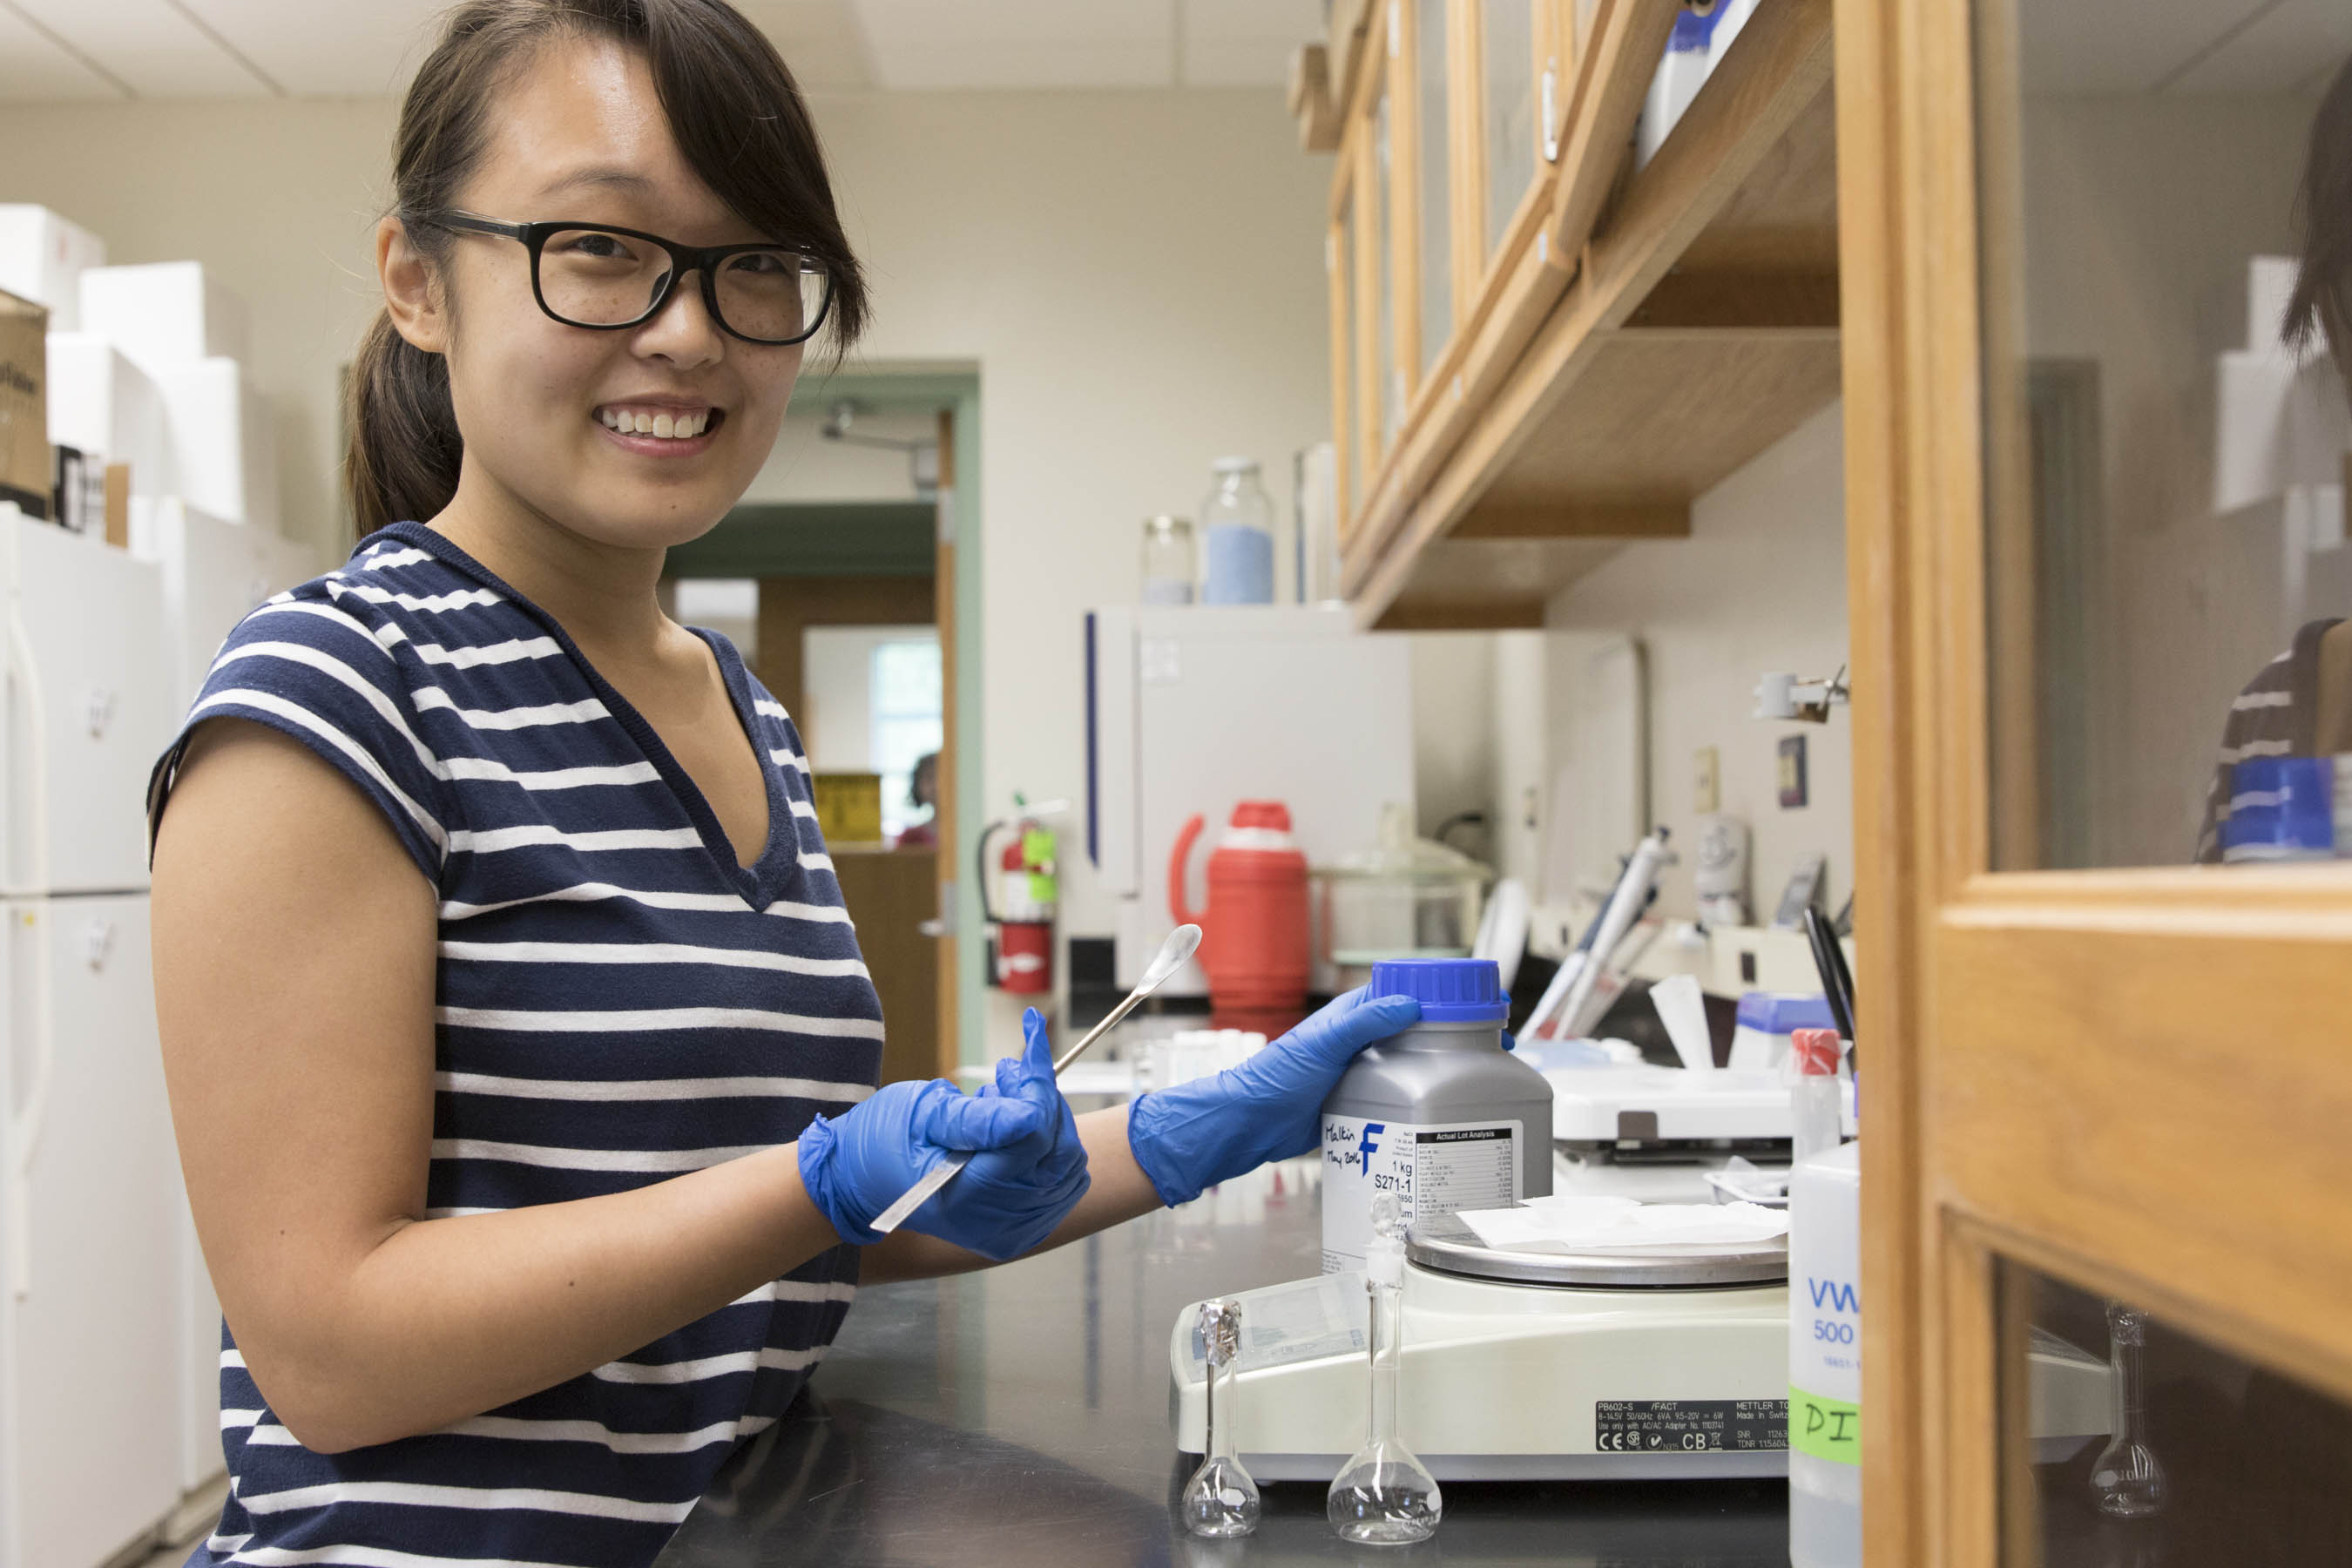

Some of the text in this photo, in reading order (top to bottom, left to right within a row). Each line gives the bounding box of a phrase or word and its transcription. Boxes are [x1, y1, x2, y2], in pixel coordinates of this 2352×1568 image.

[1469, 1131, 1495, 1139] Analysis
[1392, 1159, 1413, 1177] 1 kg
[1375, 1173, 1411, 1193] S271-1
[1814, 1319, 1854, 1345] 500
[1598, 1402, 1678, 1411] PB602-S /FACT
[1736, 1402, 1774, 1410] METTLER
[1626, 1412, 1653, 1421] 50/60Hz
[1657, 1412, 1671, 1421] 6VA
[1713, 1412, 1724, 1421] 6W
[1736, 1411, 1754, 1420] Made
[1612, 1422, 1624, 1431] only
[1665, 1422, 1687, 1431] Adapter
[1806, 1403, 1857, 1442] DI
[1682, 1433, 1706, 1450] CB
